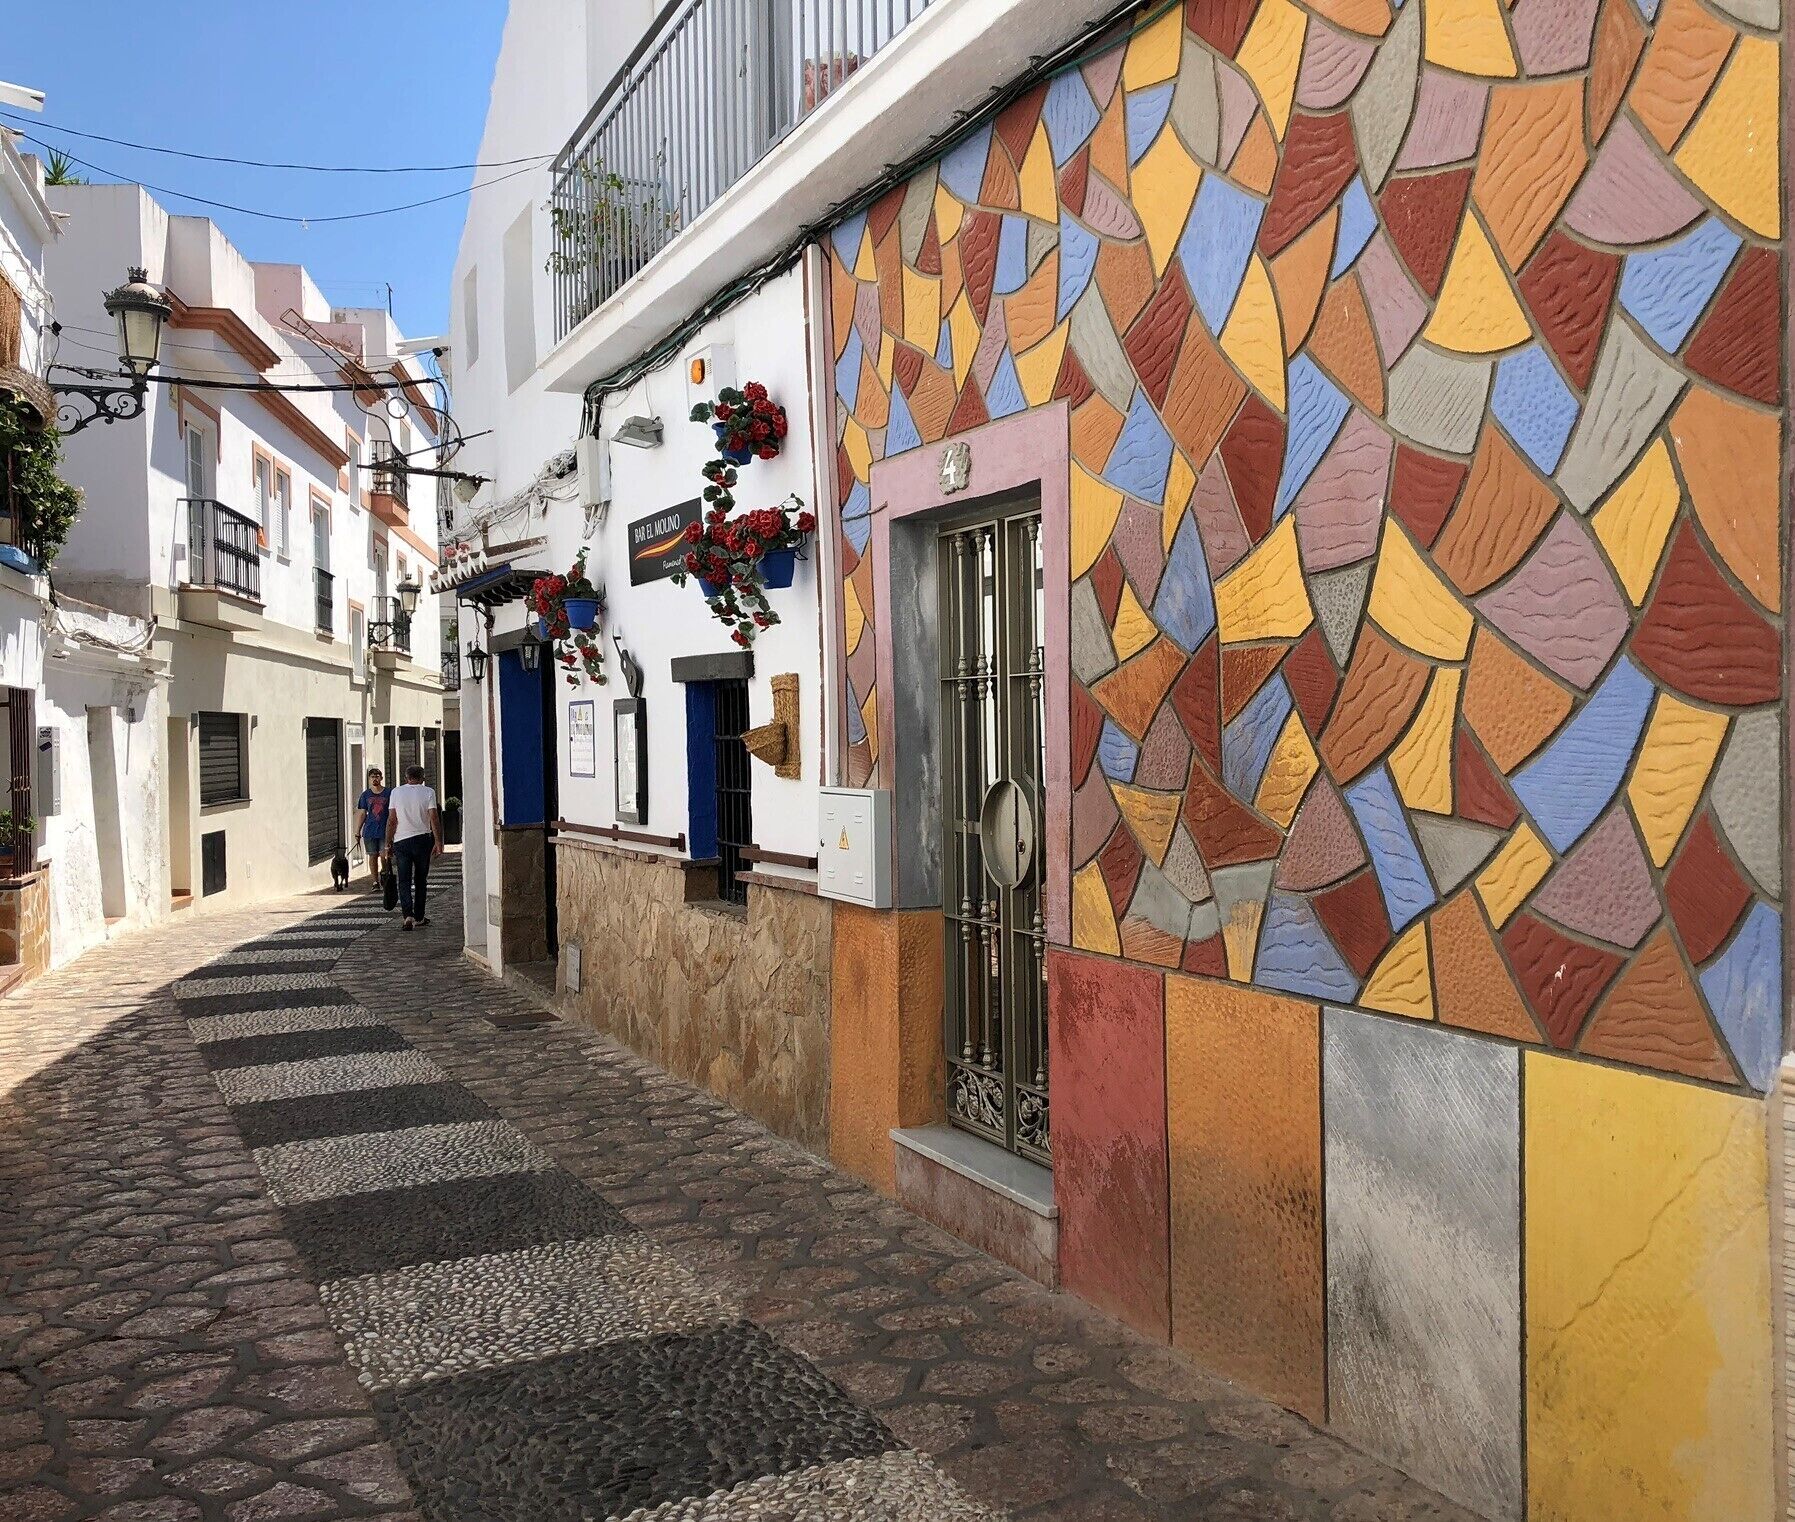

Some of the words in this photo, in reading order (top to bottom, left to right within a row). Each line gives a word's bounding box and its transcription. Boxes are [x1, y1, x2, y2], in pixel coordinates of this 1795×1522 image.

[942, 449, 957, 485] 4
[634, 525, 646, 544] BAR
[646, 523, 654, 540] EL
[654, 513, 680, 536] MOLINO
